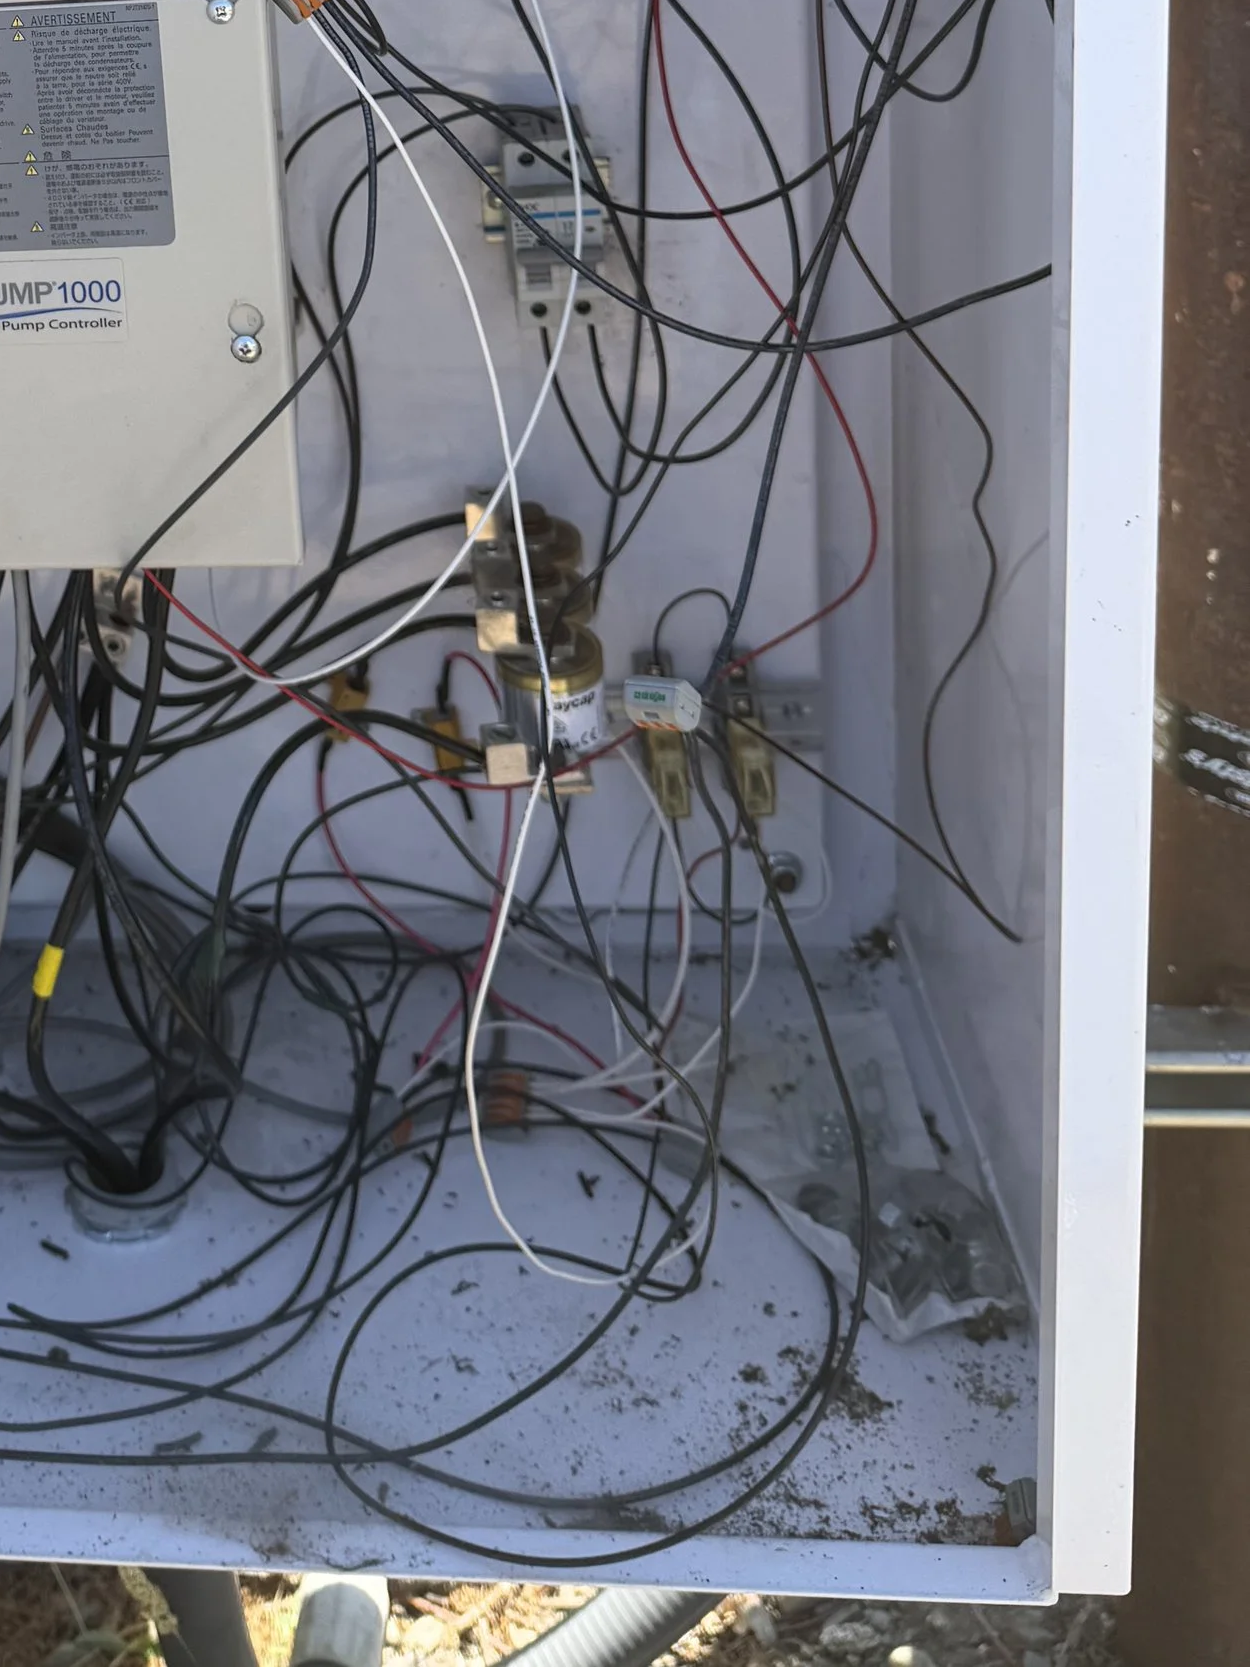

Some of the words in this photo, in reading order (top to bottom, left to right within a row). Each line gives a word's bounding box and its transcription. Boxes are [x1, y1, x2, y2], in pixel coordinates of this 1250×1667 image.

[30, 11, 116, 26] AVERTISSEMENT
[31, 29, 55, 38] Risque
[126, 41, 152, 49] coupure
[108, 49, 139, 57] permettre
[97, 64, 127, 72] exigences
[40, 125, 72, 133] Surfaces
[76, 123, 108, 131] Chaudes
[2, 319, 45, 332] Pump
[49, 317, 122, 330] Controller
[553, 691, 595, 712] aycap
